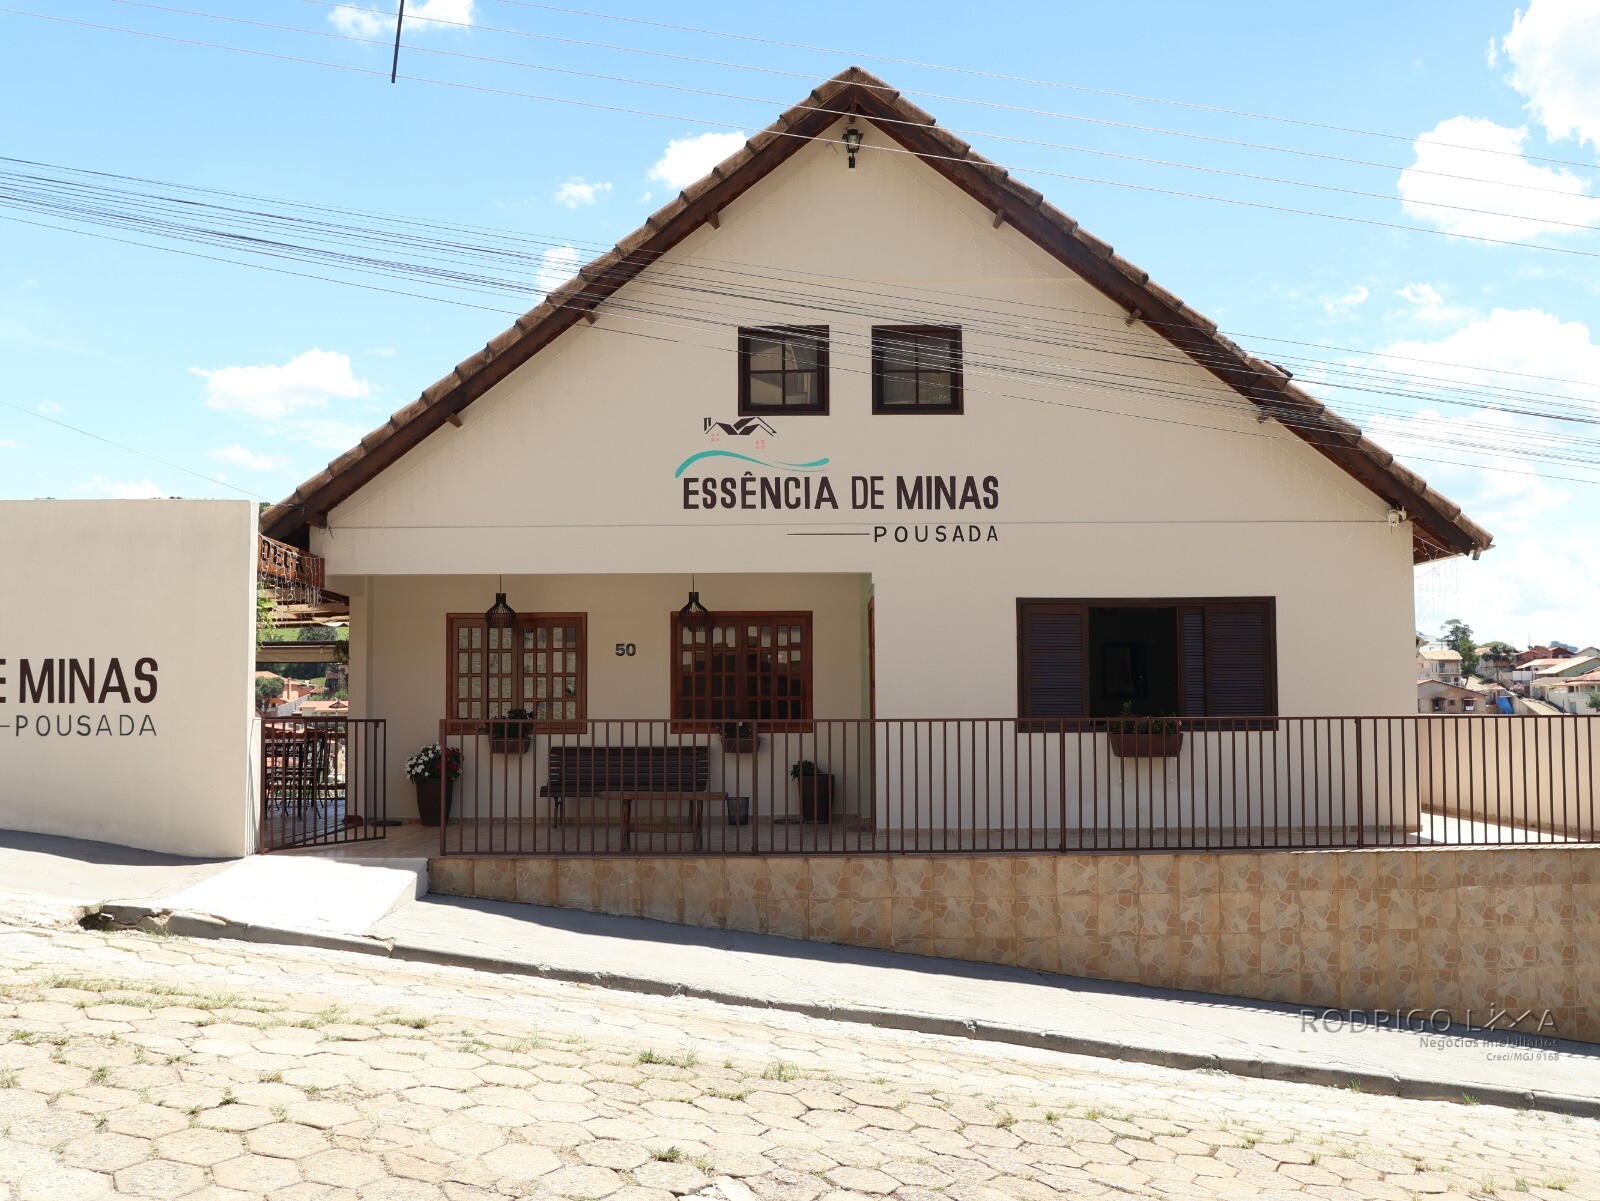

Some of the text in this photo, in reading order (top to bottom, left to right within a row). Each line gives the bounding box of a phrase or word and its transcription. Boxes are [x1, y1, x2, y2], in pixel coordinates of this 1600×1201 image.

[682, 471, 999, 510] ESSÊNCIA DE MINAS
[873, 524, 999, 543] POUSADA
[615, 643, 637, 656] 50
[19, 657, 159, 704] MINAS
[15, 714, 157, 737] POUSADA
